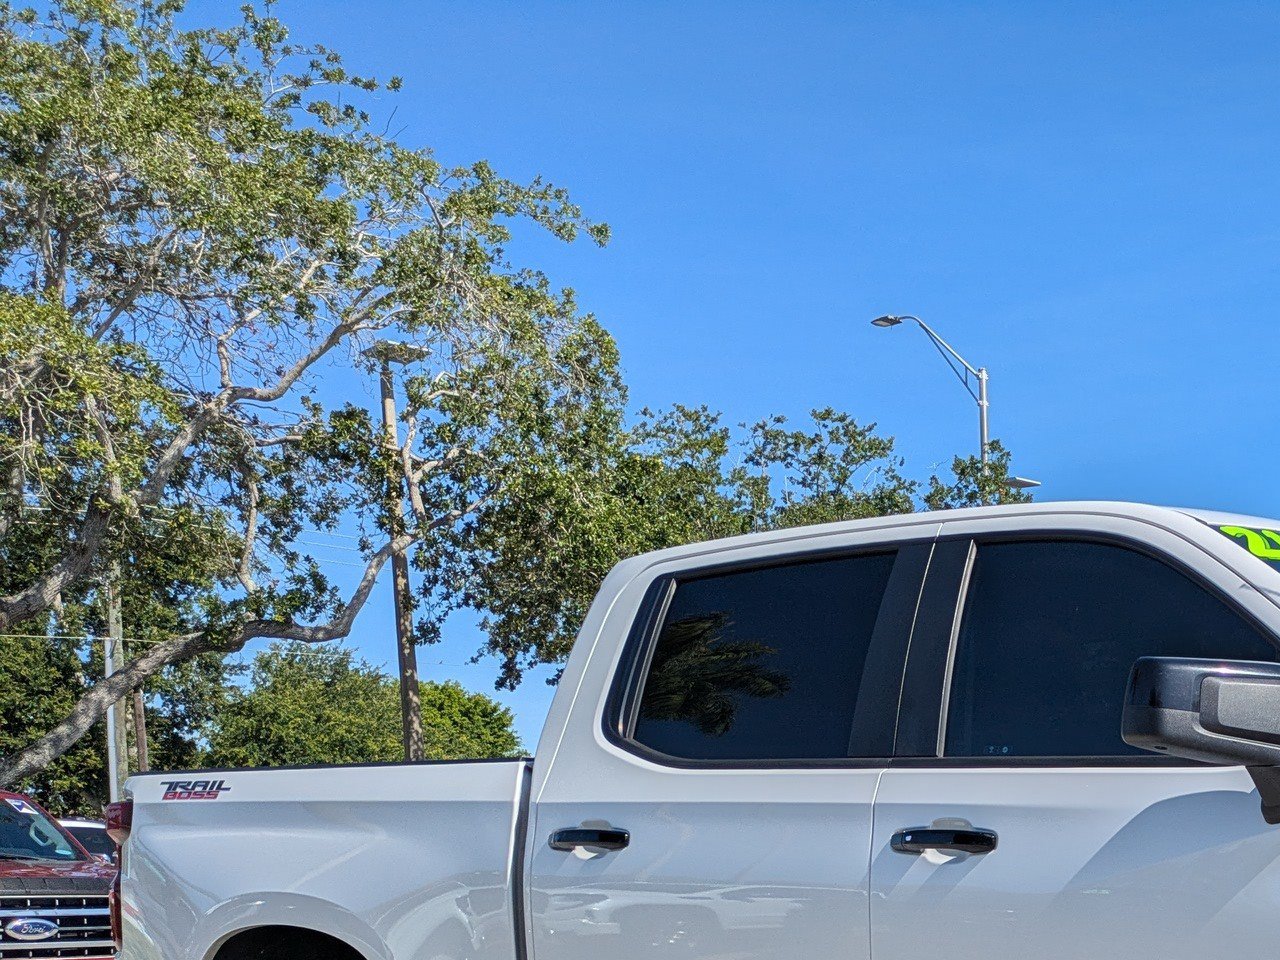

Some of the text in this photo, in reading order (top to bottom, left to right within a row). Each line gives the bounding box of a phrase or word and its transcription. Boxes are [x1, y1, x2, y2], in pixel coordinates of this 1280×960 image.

[160, 780, 231, 792] TRAIL
[162, 791, 220, 800] BOSS
[20, 922, 46, 934] Ford
